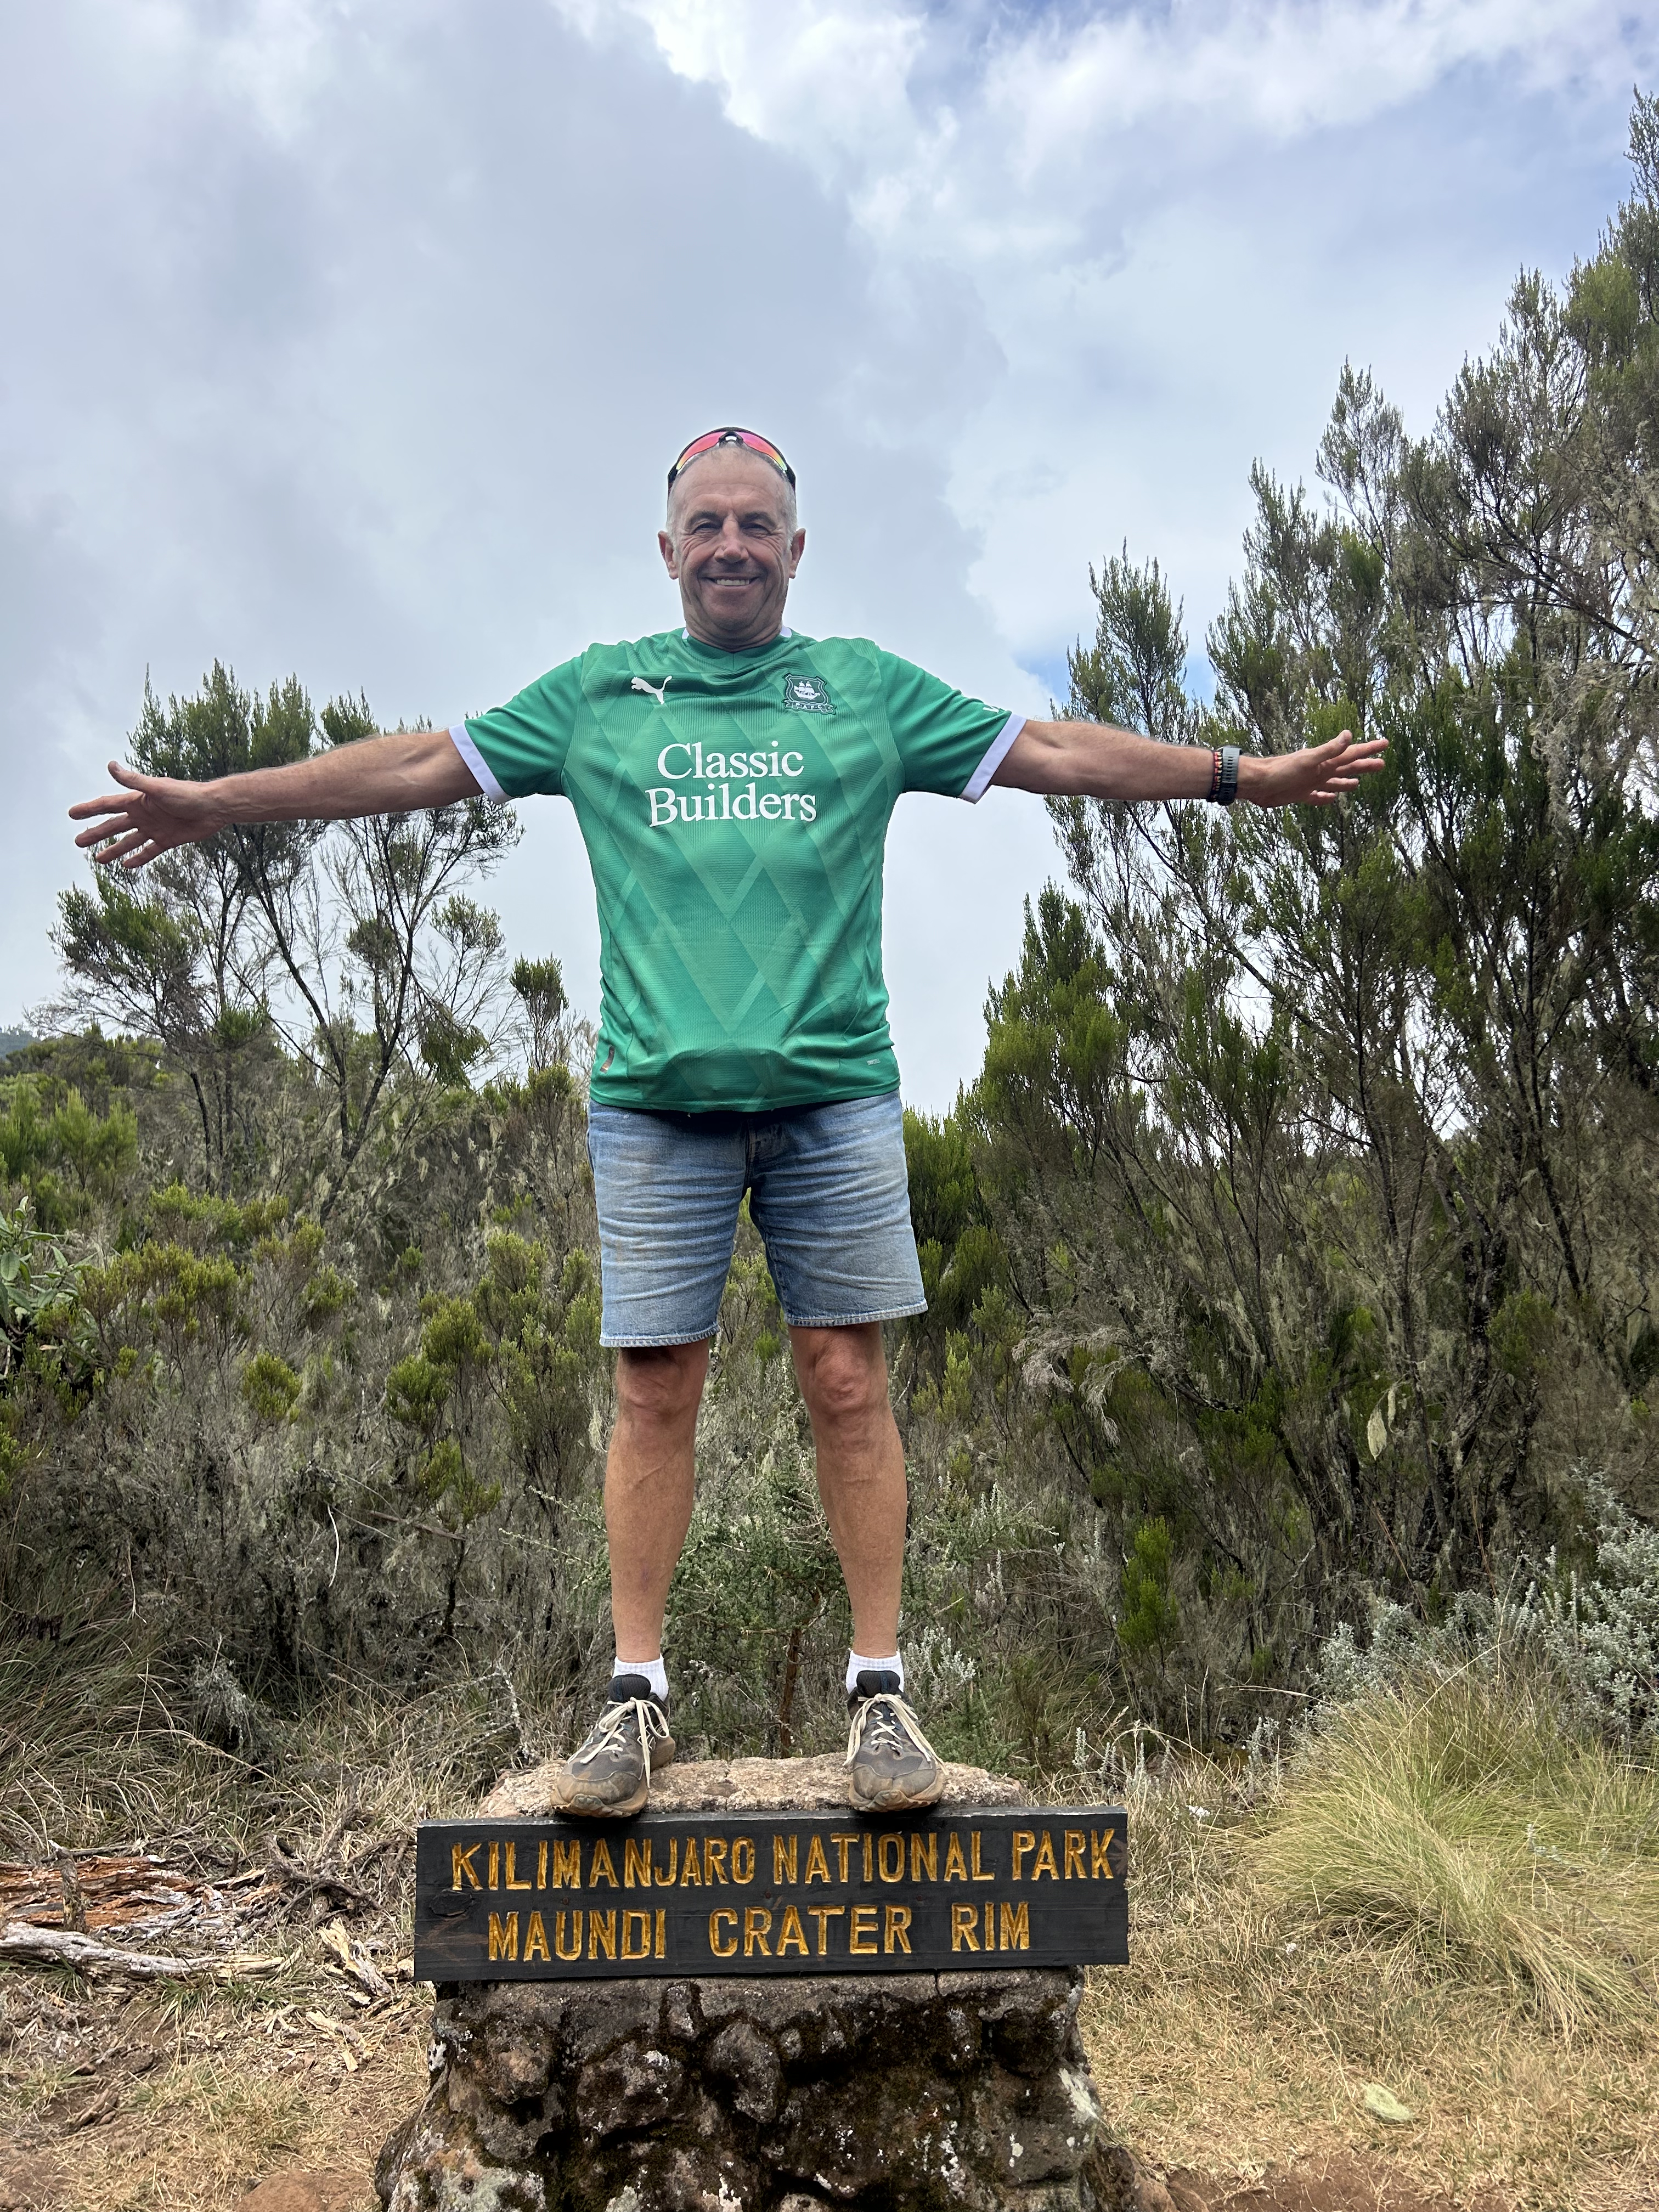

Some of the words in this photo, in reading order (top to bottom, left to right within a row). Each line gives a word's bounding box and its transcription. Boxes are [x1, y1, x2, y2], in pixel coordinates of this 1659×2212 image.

[657, 741, 804, 780] Classic
[645, 782, 817, 827] Builders
[451, 1837, 755, 1891] KILIMANJARO
[773, 1831, 995, 1883] NATIONAL
[1012, 1829, 1114, 1880] PARK
[488, 1909, 665, 1961] MAUNDI
[709, 1905, 912, 1956] CRATER
[951, 1901, 1030, 1951] RIM
